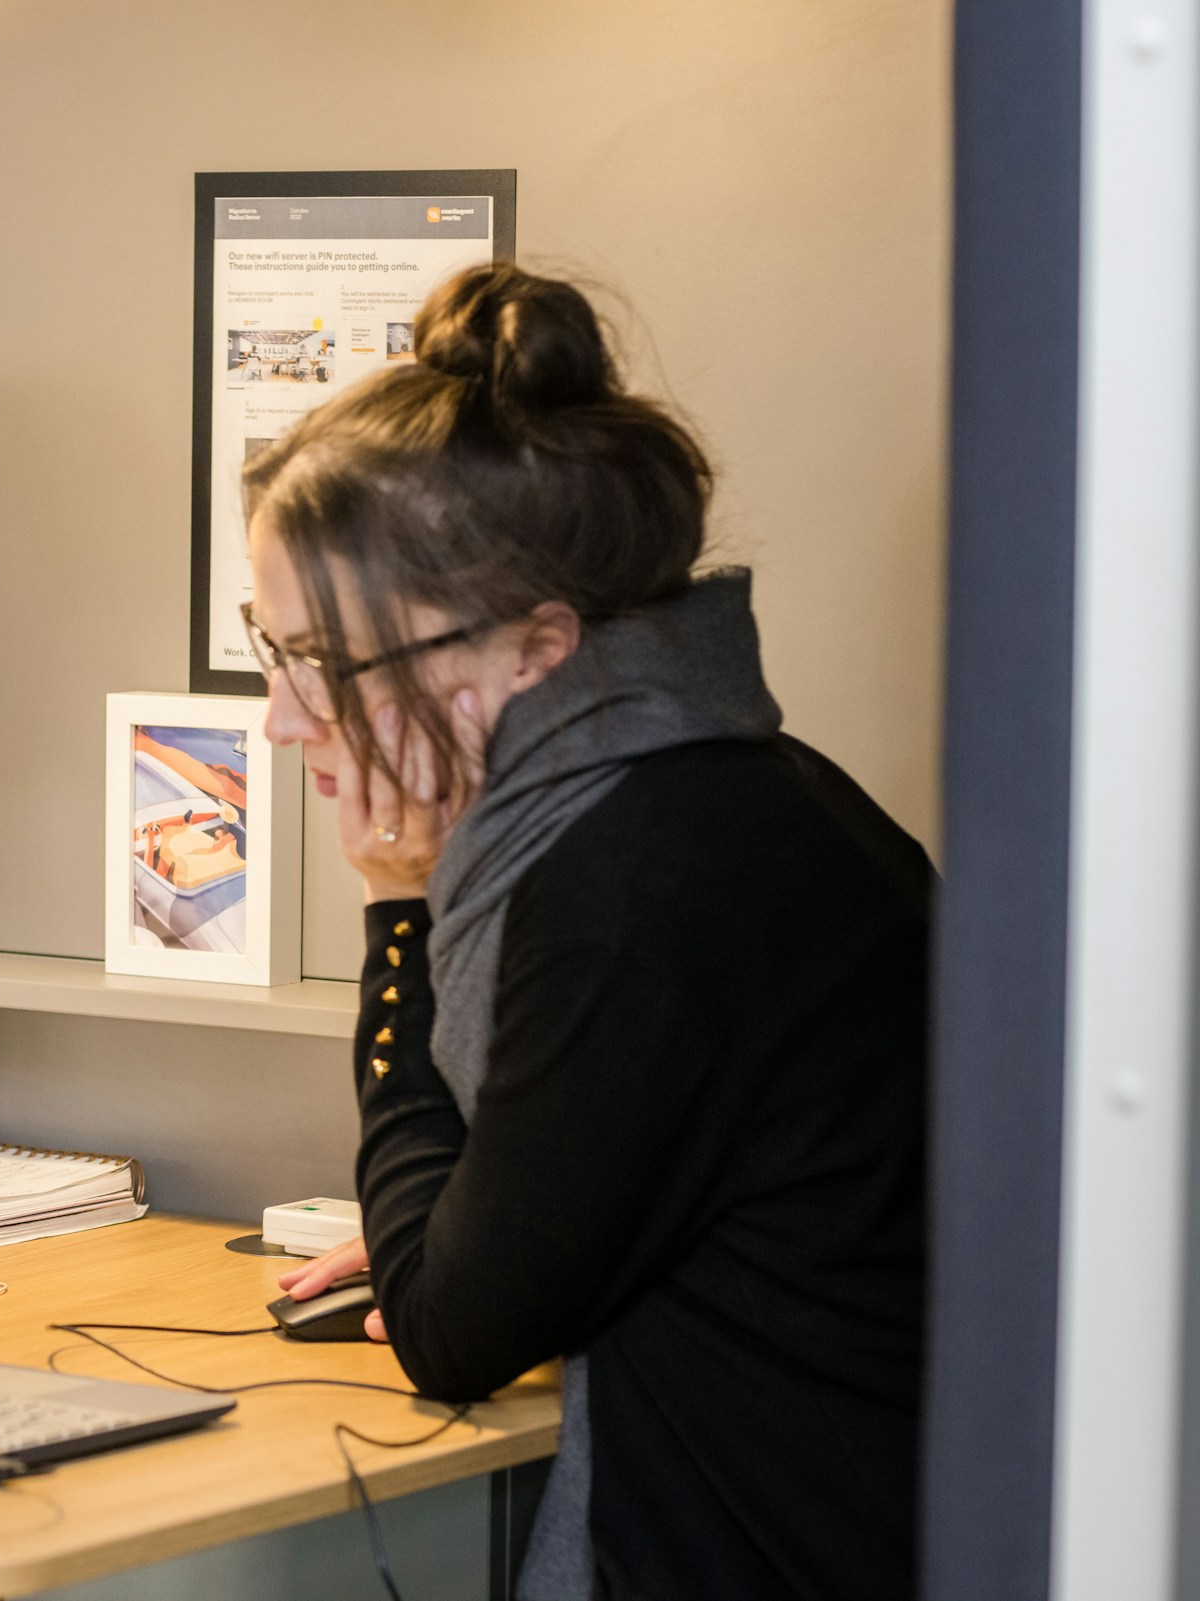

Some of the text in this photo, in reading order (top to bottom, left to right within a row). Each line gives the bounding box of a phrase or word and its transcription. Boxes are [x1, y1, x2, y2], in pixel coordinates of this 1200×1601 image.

[228, 252, 244, 260] Our
[265, 252, 280, 260] wifi
[310, 252, 316, 260] is
[318, 252, 332, 260] PIN
[334, 252, 378, 262] protected.
[228, 262, 420, 272] These instructions guide you to getting online.
[224, 648, 248, 656] Work.
